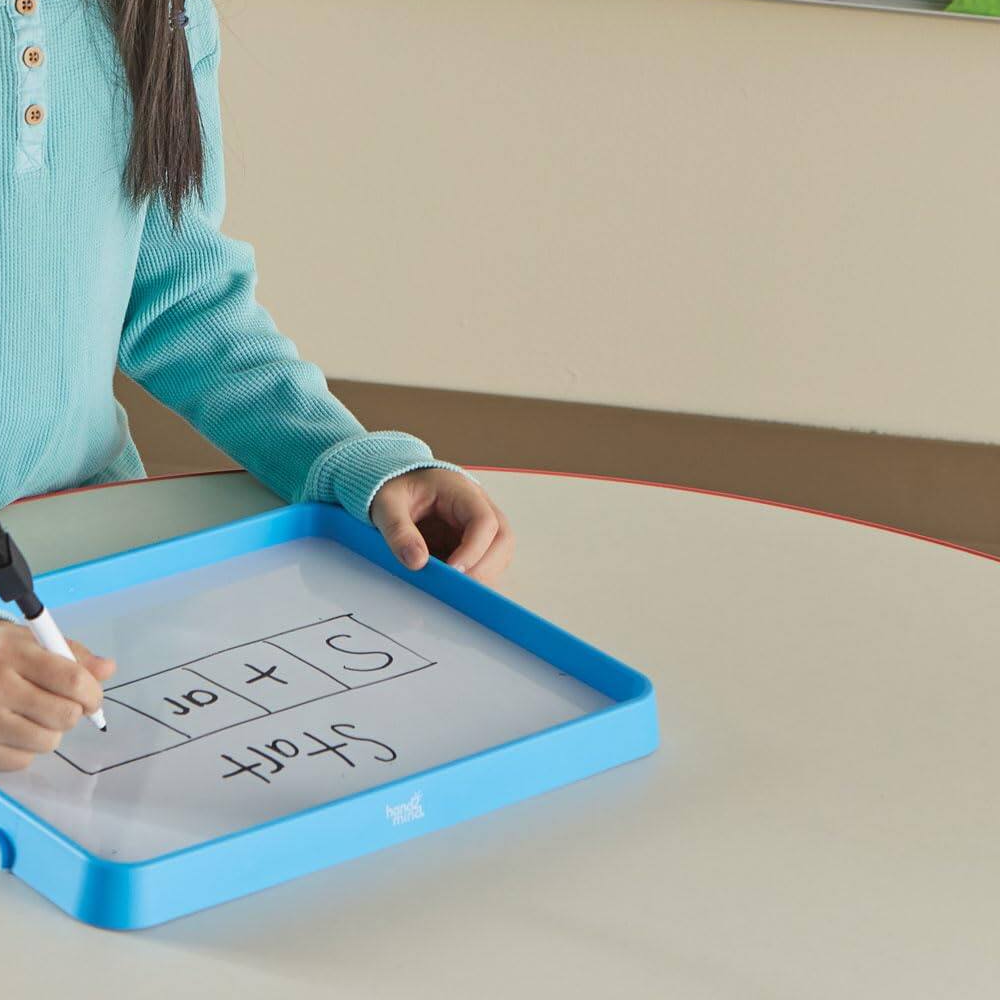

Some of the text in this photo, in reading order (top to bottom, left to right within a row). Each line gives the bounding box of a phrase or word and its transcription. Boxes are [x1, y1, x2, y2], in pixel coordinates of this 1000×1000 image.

[325, 633, 394, 672] S
[162, 688, 219, 716] ar
[220, 723, 398, 785] Start
